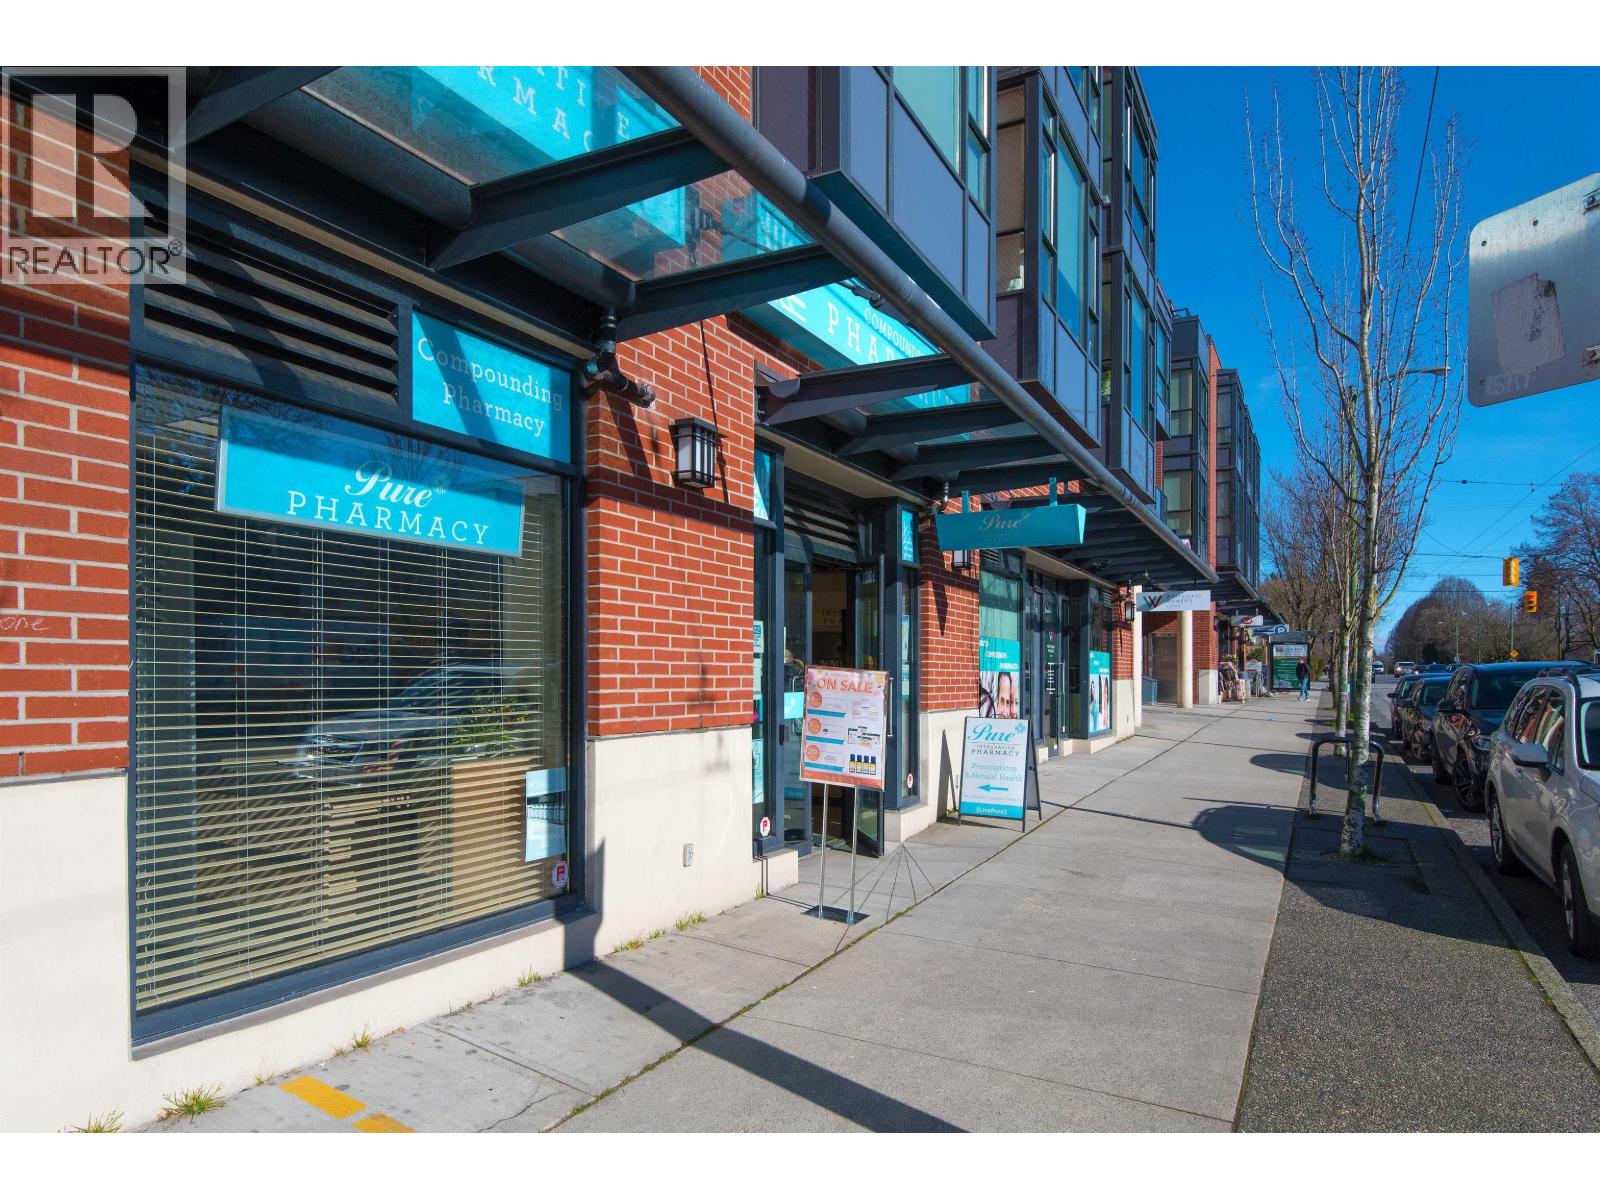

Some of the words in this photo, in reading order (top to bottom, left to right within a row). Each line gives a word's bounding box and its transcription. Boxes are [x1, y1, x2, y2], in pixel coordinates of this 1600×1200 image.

[417, 337, 563, 412] Compounding
[442, 381, 545, 438] Pharmacy
[344, 460, 433, 509] Pure
[287, 490, 489, 545] PHARMACY
[840, 679, 874, 694] SALE
[967, 722, 1016, 742] Pure
[971, 748, 1020, 757] PHARMACY
